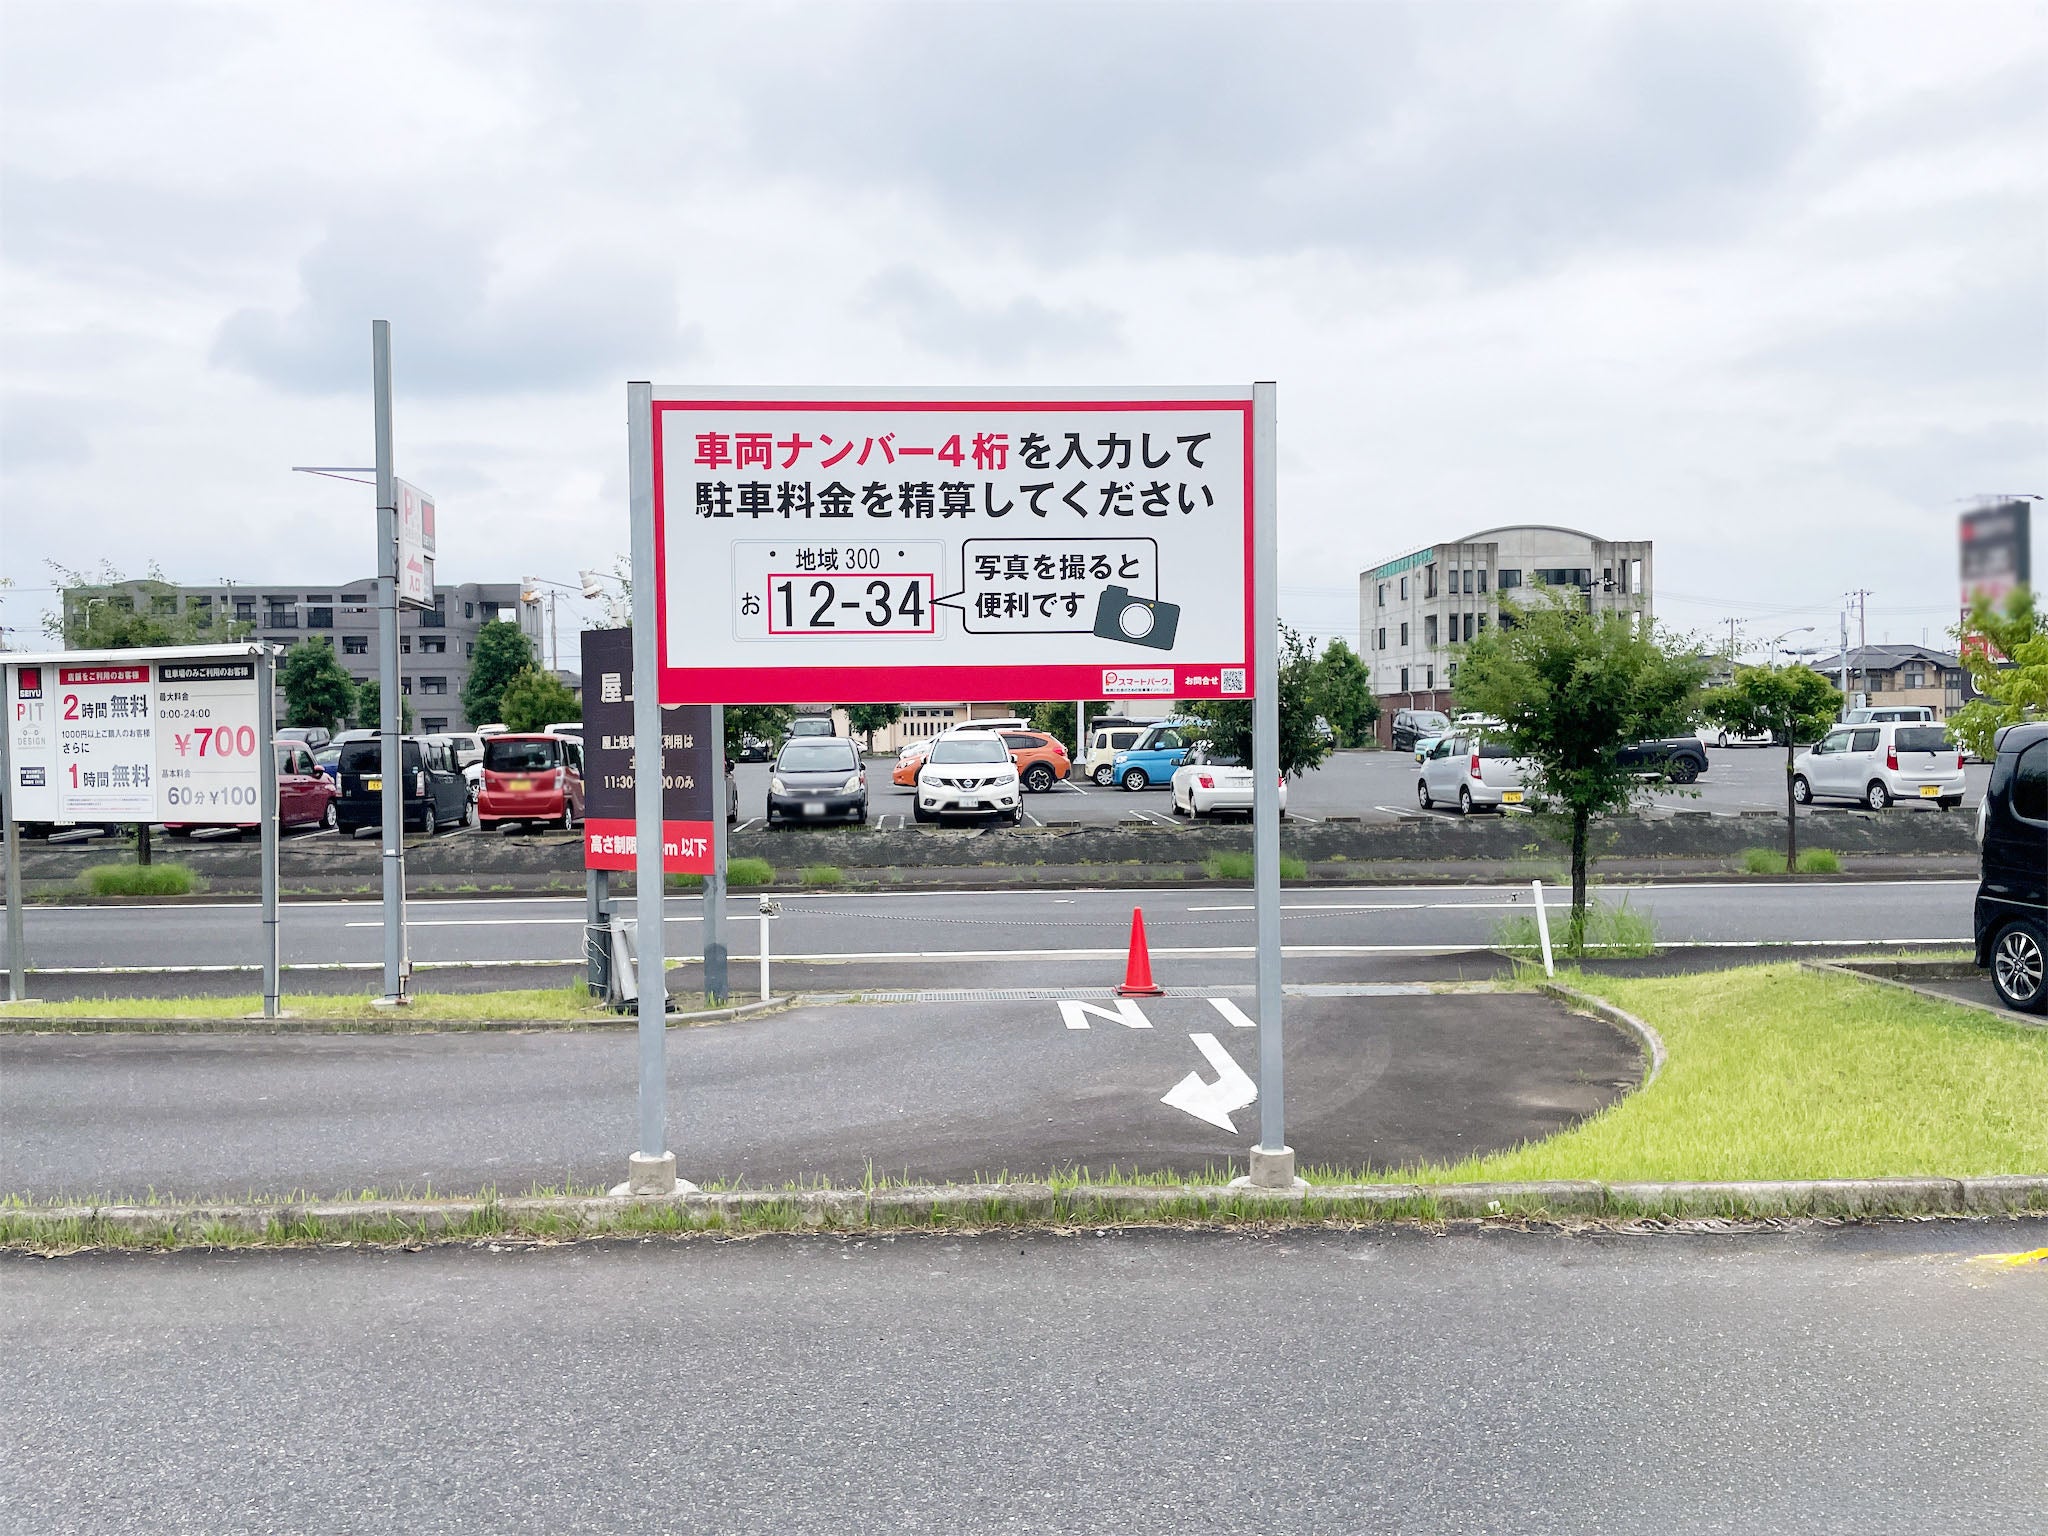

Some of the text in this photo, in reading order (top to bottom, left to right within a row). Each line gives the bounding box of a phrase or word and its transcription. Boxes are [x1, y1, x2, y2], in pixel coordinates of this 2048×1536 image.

[695, 480, 1214, 519] 駐車料金を精算してください
[796, 547, 880, 571] 地域 300
[974, 554, 1140, 580] 写真を撮ると
[741, 580, 925, 628] お 12-34
[974, 592, 1085, 618] 便利です
[164, 667, 248, 679] 駐車場のみご利用のお客様
[1185, 676, 1219, 686] お問合せ
[19, 689, 42, 698] SEIYU
[159, 692, 189, 702] 最大料金
[17, 702, 44, 721] PIT
[160, 708, 211, 719] 0:00-24:00
[18, 737, 46, 745] DESIGN
[174, 725, 256, 757] ¥700
[62, 742, 90, 754] さらに
[161, 768, 191, 779] 基本料金
